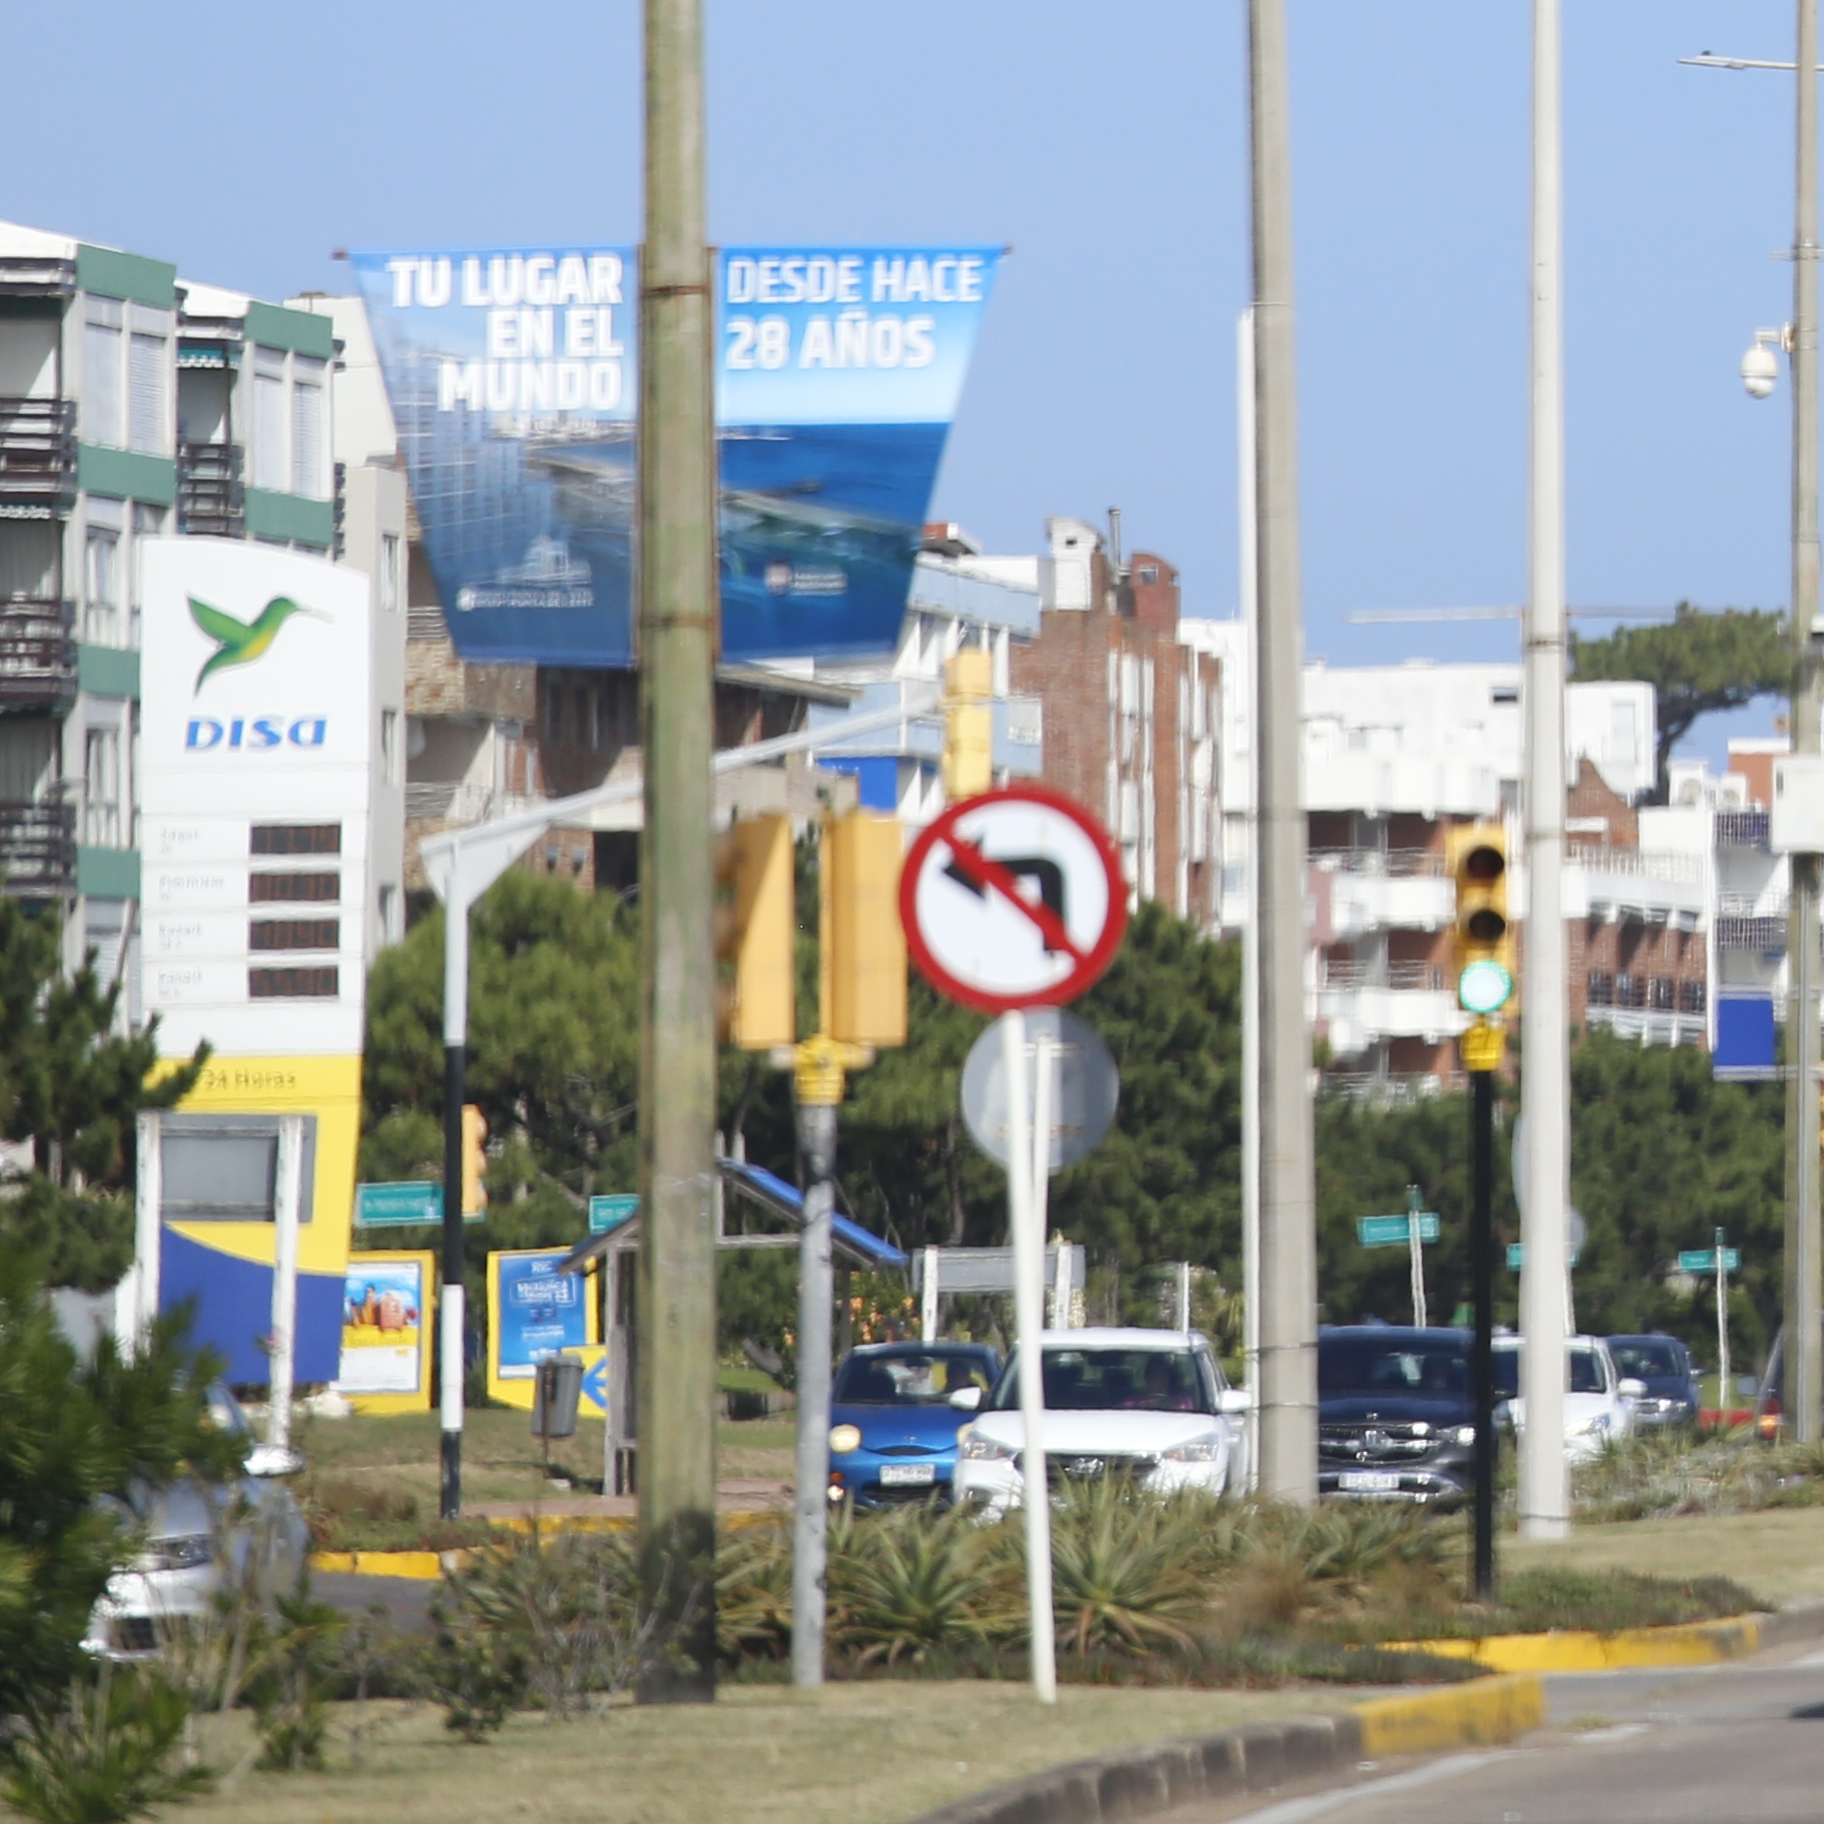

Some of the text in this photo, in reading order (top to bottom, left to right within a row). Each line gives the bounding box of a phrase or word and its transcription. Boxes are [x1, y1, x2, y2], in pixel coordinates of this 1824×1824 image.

[385, 256, 623, 308] TU LUGAR
[727, 258, 983, 304] DESDE HACE
[487, 307, 625, 358] EN EL
[726, 307, 936, 370] 28 AÑOS
[437, 361, 622, 412] MUNDO
